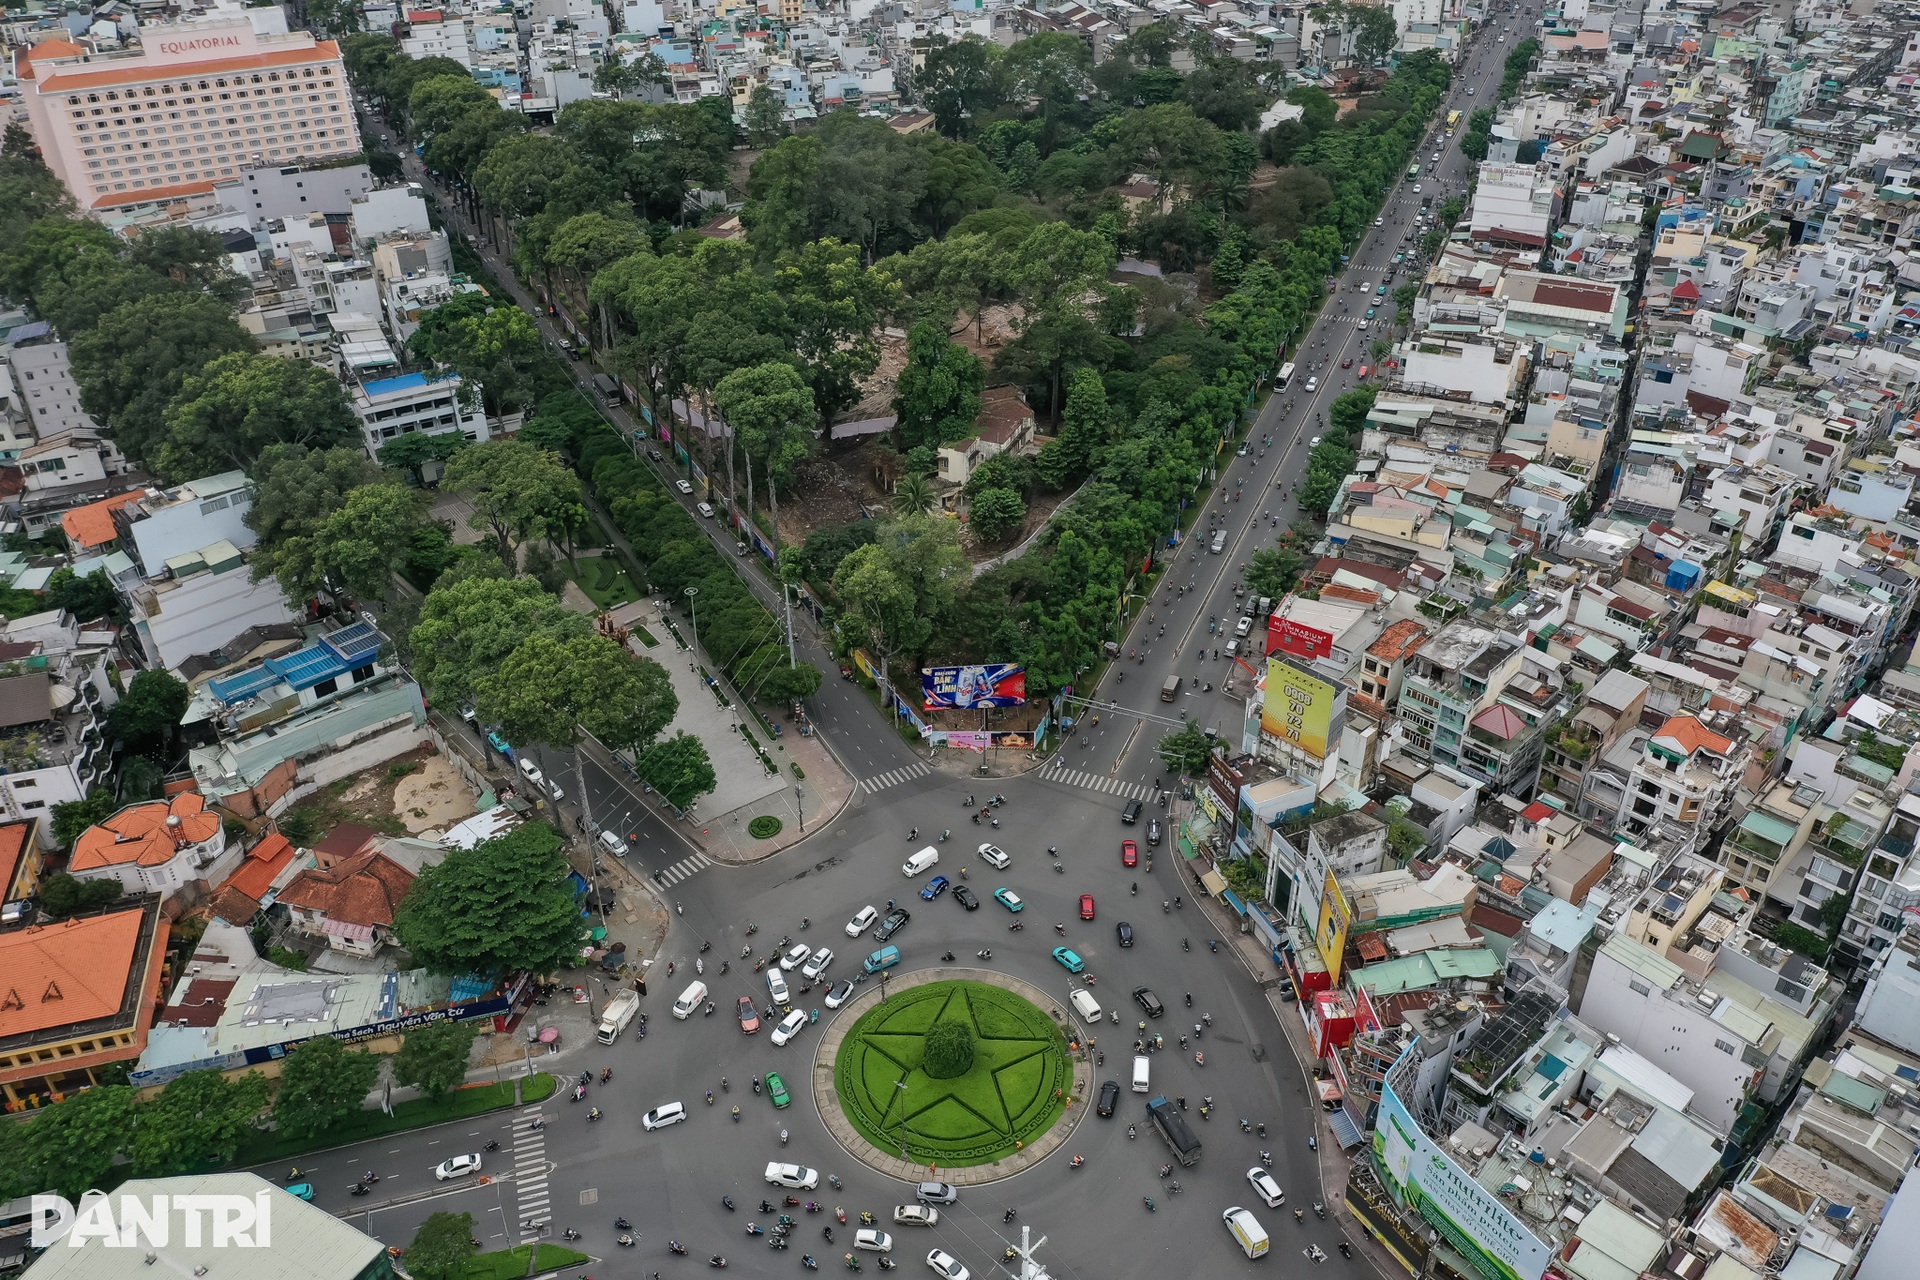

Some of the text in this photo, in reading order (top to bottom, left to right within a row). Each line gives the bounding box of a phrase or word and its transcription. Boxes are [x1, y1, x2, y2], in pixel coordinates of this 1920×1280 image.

[160, 36, 241, 54] EQUATORIAL
[1284, 685, 1312, 706] 0908
[1289, 700, 1304, 720] 70
[1286, 726, 1300, 742] 71
[1287, 713, 1302, 734] 72
[342, 1018, 454, 1045] GUYENVANCU OOKSRE
[1447, 1169, 1521, 1241] nutrilite
[1480, 1216, 1520, 1256] protein
